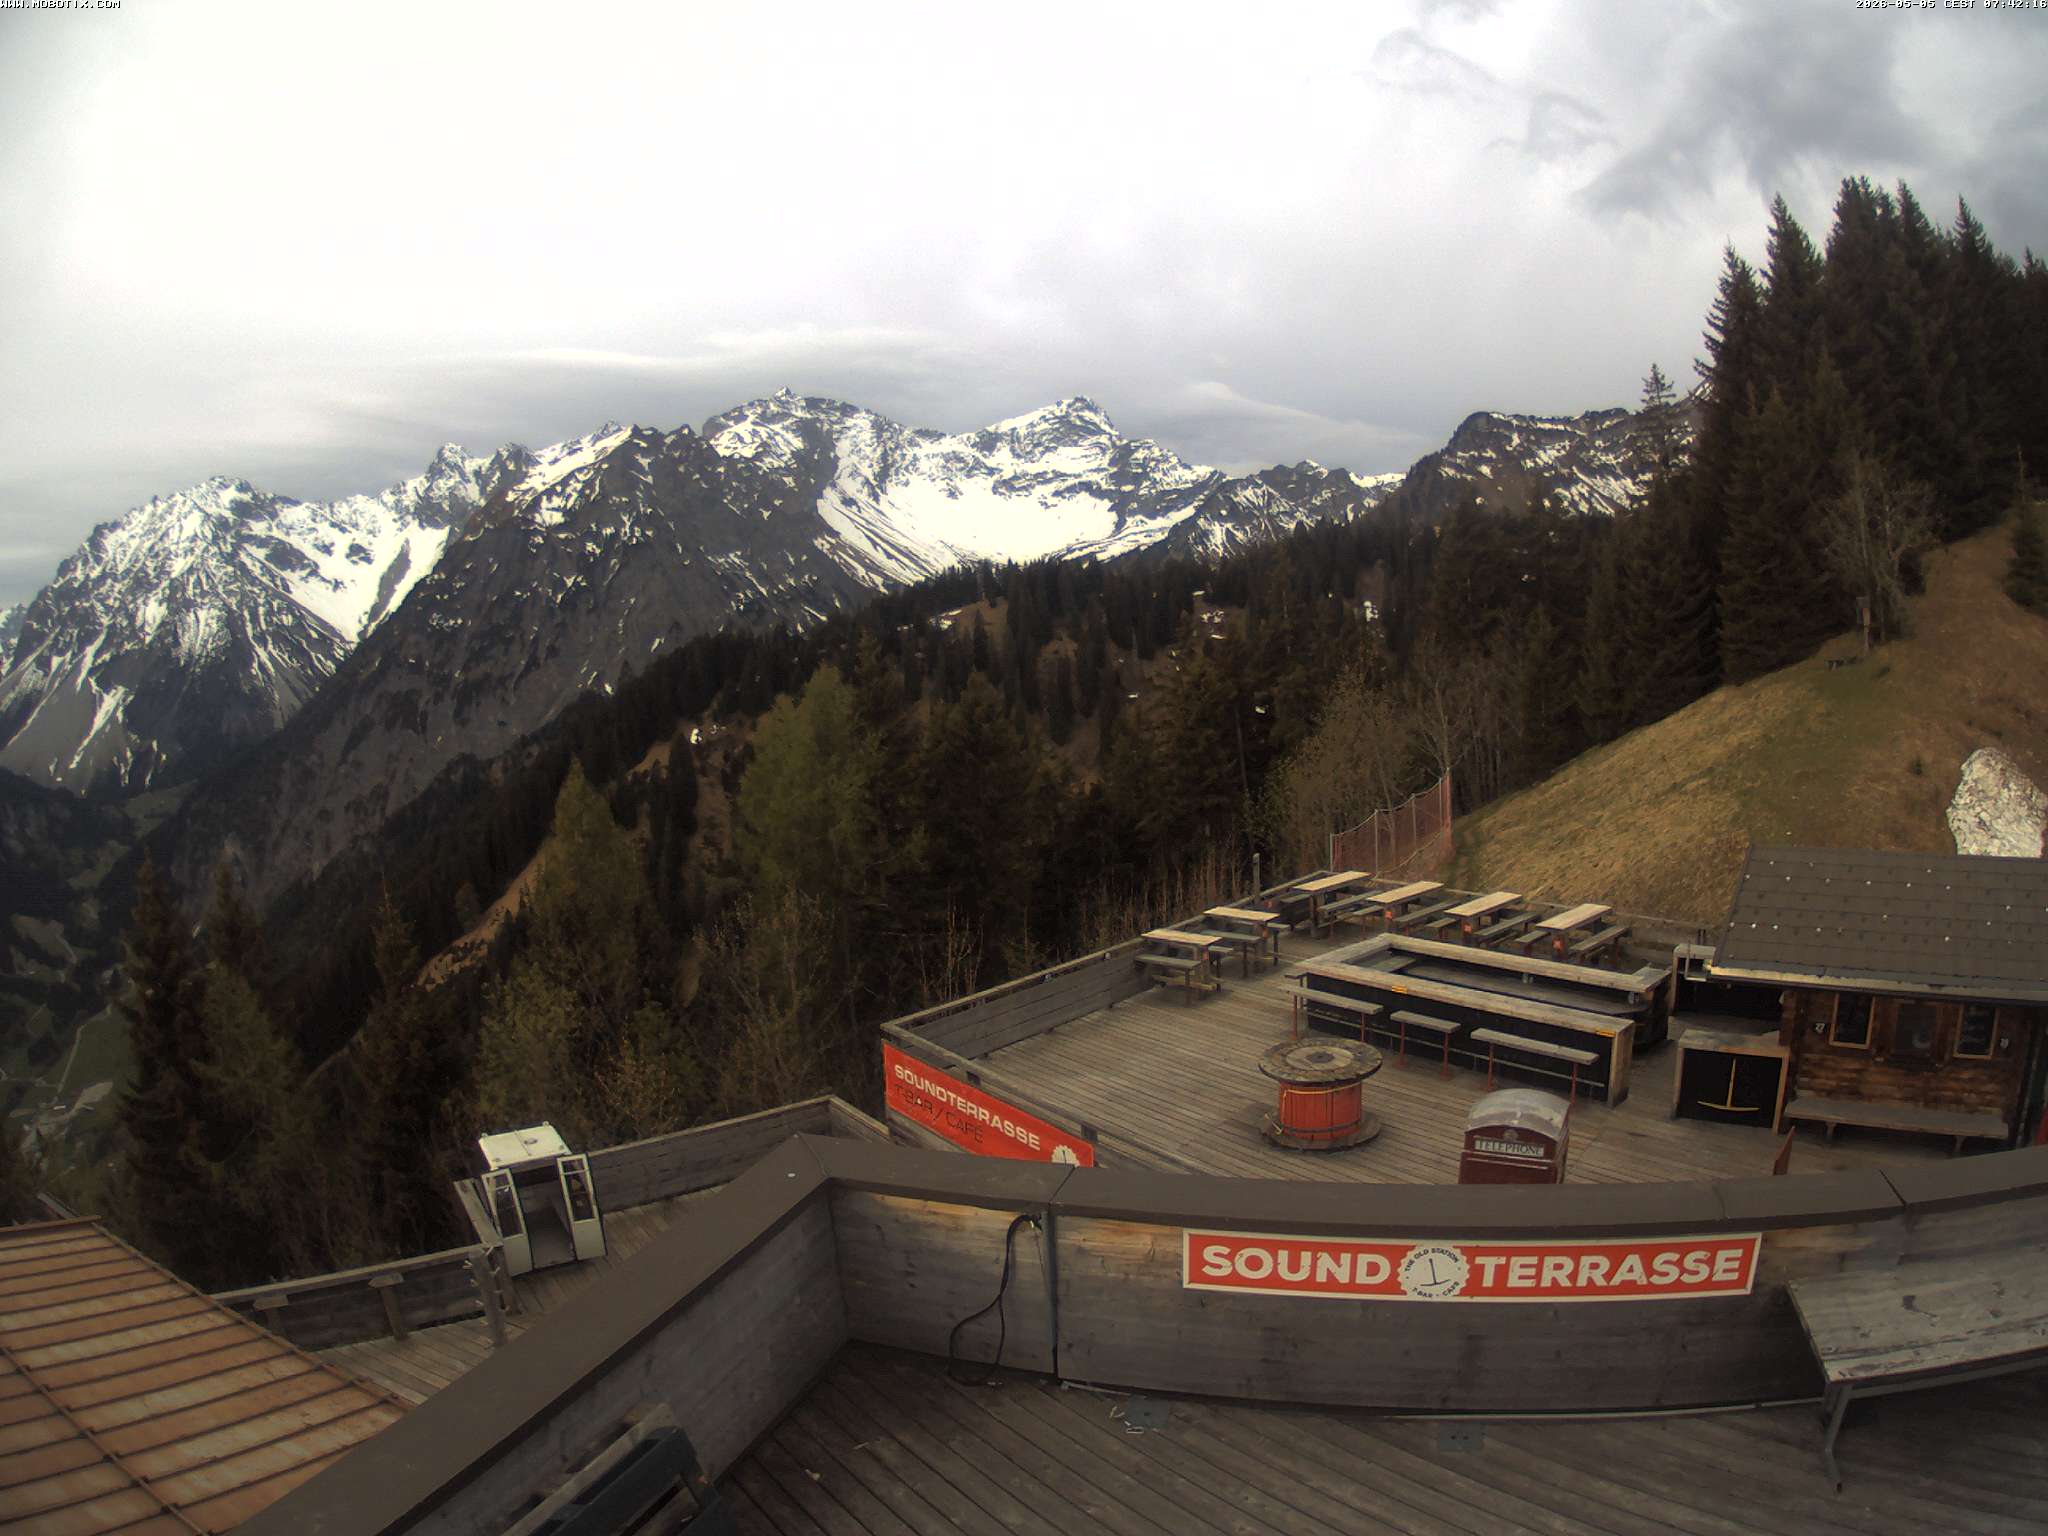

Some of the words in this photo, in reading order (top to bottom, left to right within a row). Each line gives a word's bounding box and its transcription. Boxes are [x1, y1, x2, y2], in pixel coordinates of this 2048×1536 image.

[894, 1064, 1041, 1151] SOUNDTERRASSE
[1475, 1140, 1544, 1157] TELEPHONE
[1202, 1245, 1391, 1285] SOUND
[1414, 1249, 1429, 1260] OLD
[1474, 1248, 1745, 1289] TERRASSE
